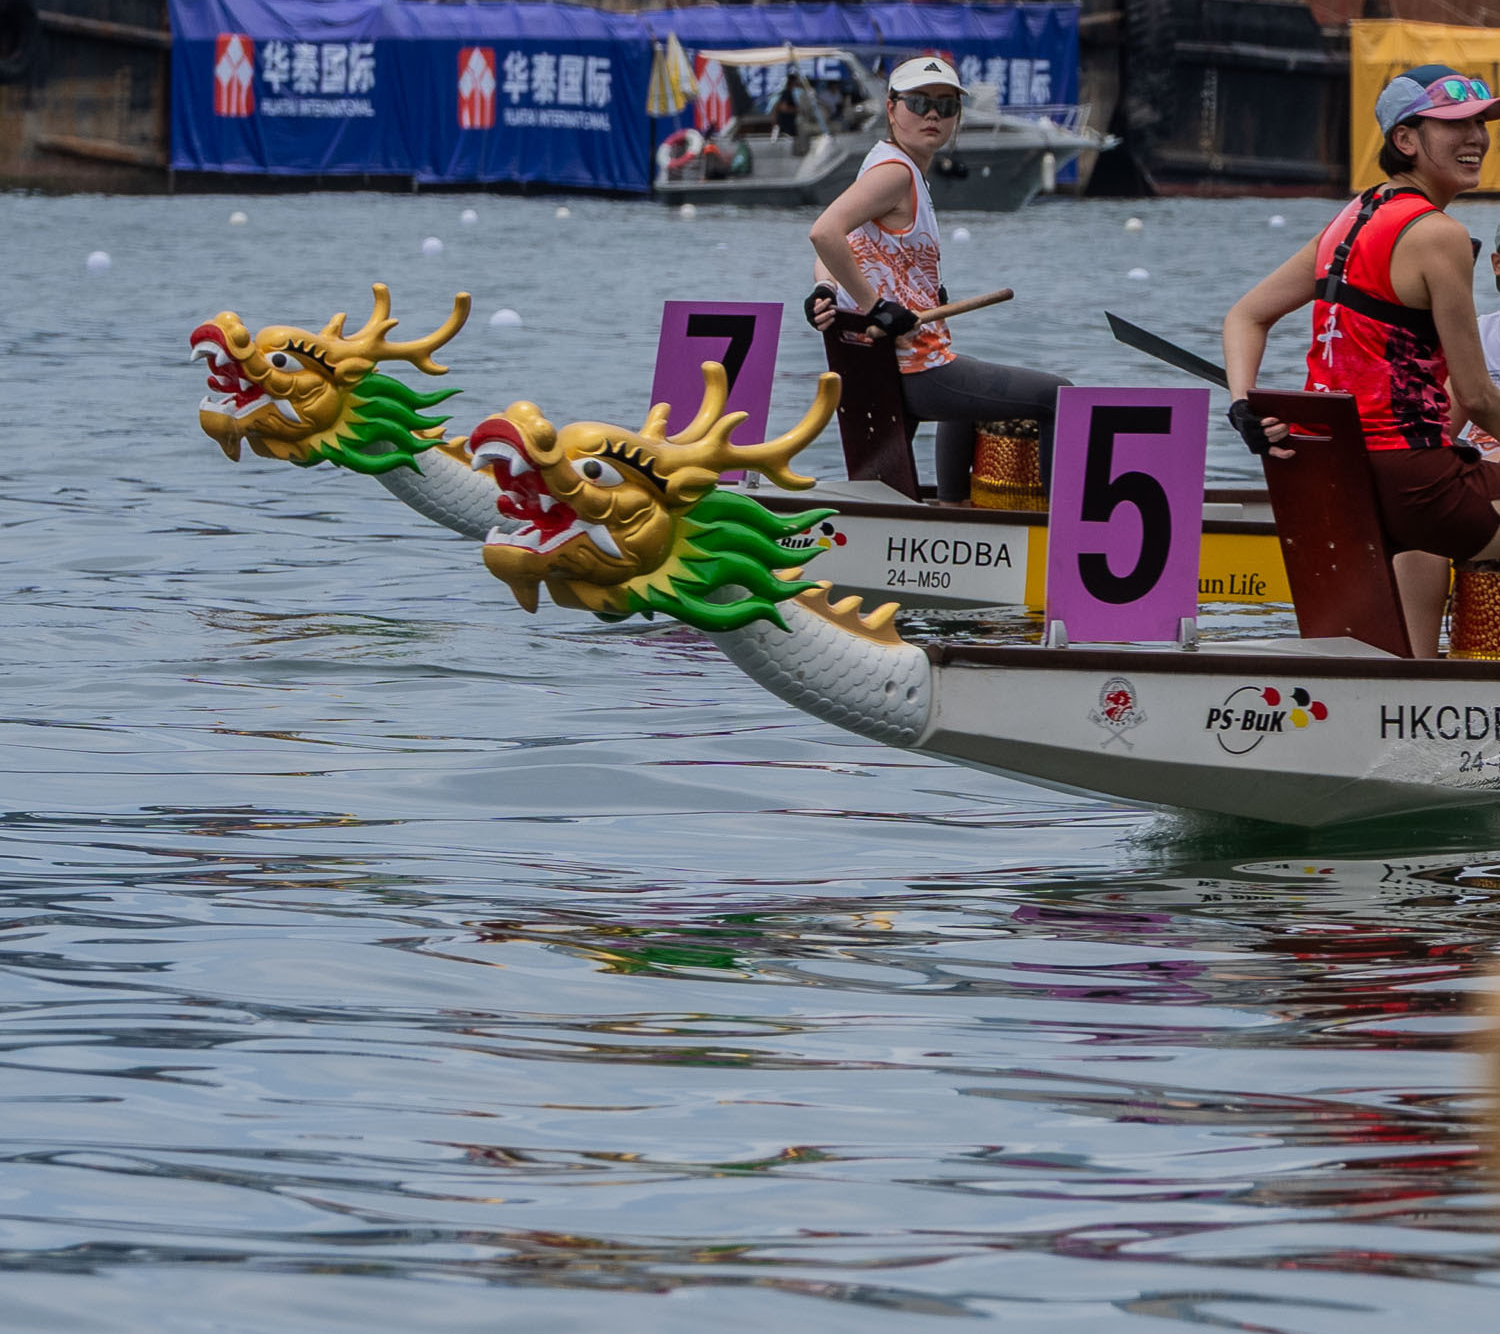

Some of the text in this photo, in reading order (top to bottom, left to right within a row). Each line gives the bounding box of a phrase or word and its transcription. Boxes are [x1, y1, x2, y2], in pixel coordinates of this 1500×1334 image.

[262, 39, 376, 94] 华泰国际
[502, 50, 613, 105] 华泰国际
[686, 313, 757, 405] 7
[1077, 405, 1173, 605] 5
[886, 536, 1013, 569] HKCDBA
[886, 569, 952, 590] 24-M50
[1198, 573, 1267, 597] un Life
[1206, 707, 1288, 733] PS-BuK
